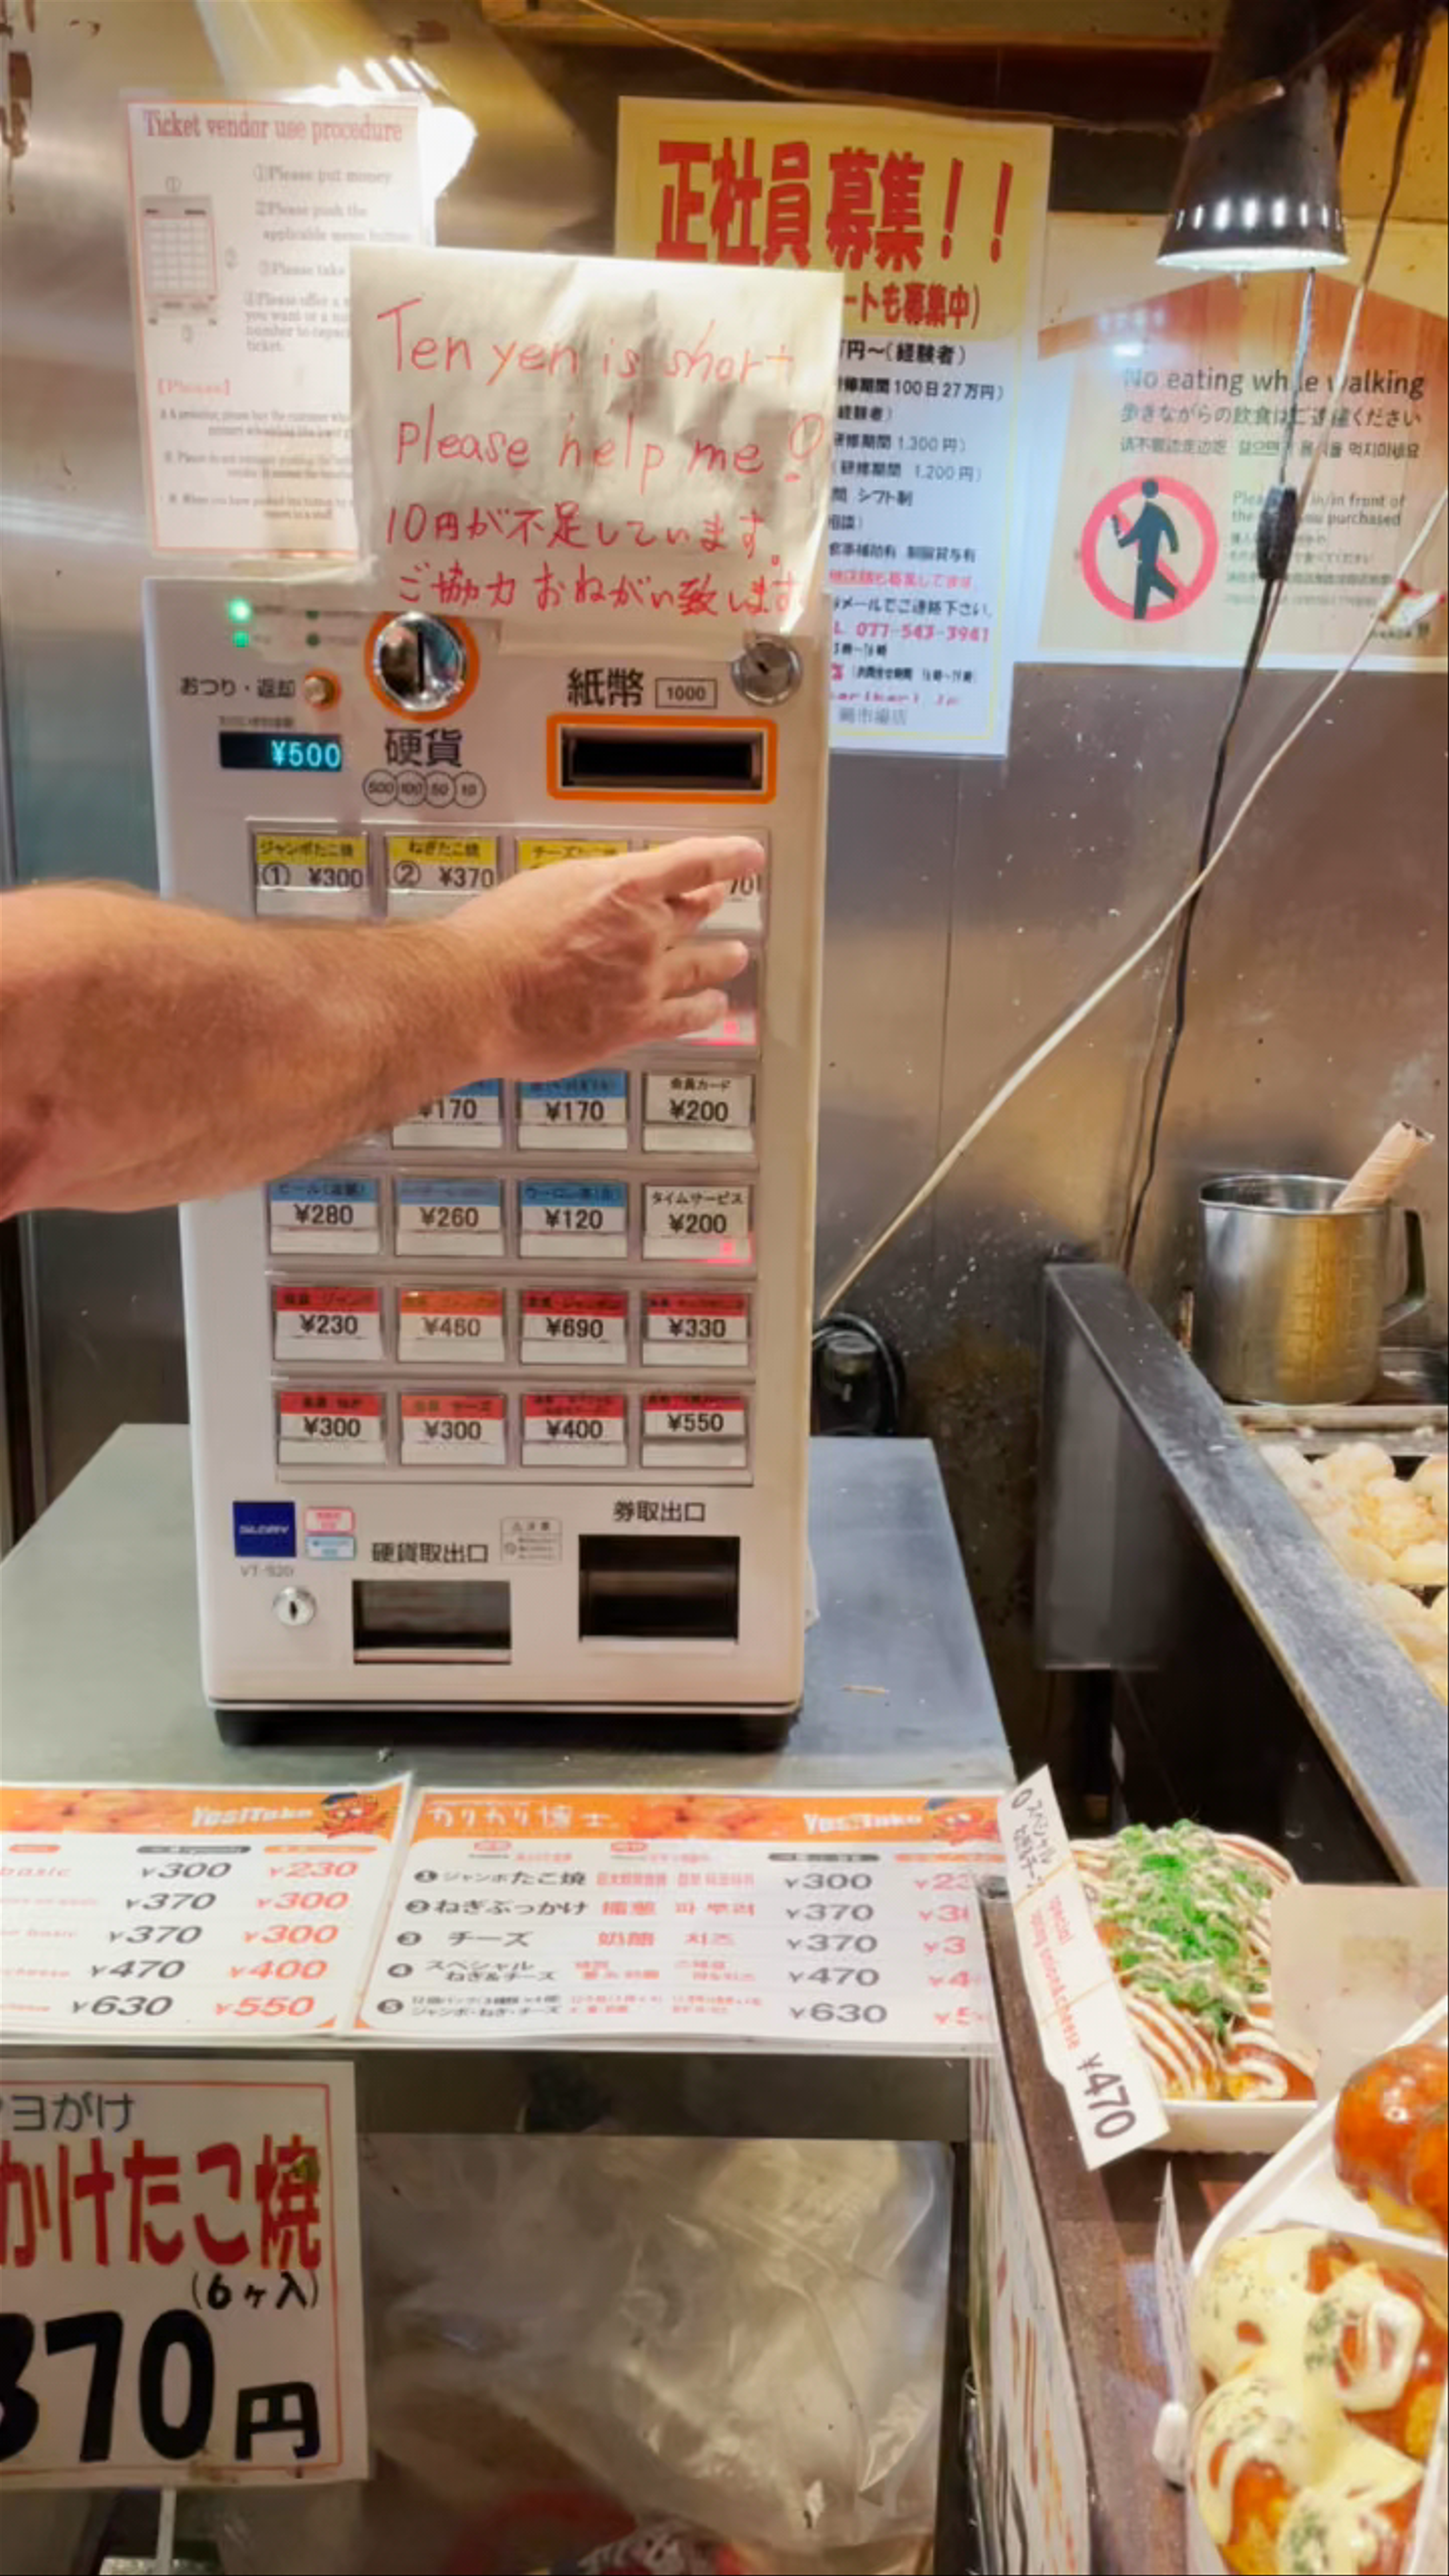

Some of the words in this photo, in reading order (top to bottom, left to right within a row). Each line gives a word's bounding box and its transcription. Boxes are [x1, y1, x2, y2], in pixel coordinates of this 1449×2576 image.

[145, 109, 200, 138] Ticket
[208, 112, 268, 140] vendor
[274, 119, 306, 140] use
[313, 114, 402, 144] procedure
[318, 168, 341, 184] put
[378, 297, 472, 372] Ten
[490, 343, 579, 386] yen
[604, 338, 640, 378] is
[665, 320, 795, 384] short
[1123, 368, 1158, 389] No
[1167, 367, 1244, 397] eating
[1253, 369, 1318, 393] whle
[559, 411, 665, 495] help
[567, 667, 644, 707] 紙幣
[666, 686, 706, 701] 1000
[272, 739, 340, 768] ¥500
[385, 728, 462, 767] 硬貨
[368, 781, 395, 795] 500
[400, 781, 423, 795] 100
[431, 782, 448, 795] 50
[461, 782, 477, 796] 10
[308, 868, 364, 888] ¥300
[438, 866, 495, 888] ¥370
[545, 1100, 605, 1122] ¥170
[669, 1100, 729, 1122] ¥200
[652, 1191, 744, 1206] タイムサービス
[293, 1204, 354, 1225] ¥280
[419, 1207, 480, 1227] ¥260
[545, 1209, 604, 1229] ¥120
[668, 1213, 727, 1234] ¥200
[298, 1314, 358, 1335] ¥230
[545, 1317, 604, 1339] ¥690
[668, 1318, 726, 1338] ¥330
[303, 1416, 362, 1438] ¥300
[424, 1420, 482, 1440] ¥300
[546, 1419, 604, 1439] ¥400
[666, 1412, 724, 1433] ¥550
[613, 1500, 706, 1523] 券取出口
[371, 1541, 489, 1564] 硬貨取出口
[142, 1862, 232, 1879] ¥300
[269, 1861, 359, 1879] ¥230
[785, 1873, 873, 1891] ¥300
[126, 1893, 217, 1910] ¥370
[256, 1892, 350, 1910] ¥300
[434, 1899, 589, 1915] ねぎぶっかけ
[786, 1904, 875, 1922] ¥370
[109, 1925, 203, 1944] ¥370
[244, 1924, 339, 1944] ¥300
[448, 1932, 534, 1947] チーズ
[787, 1934, 878, 1953] ¥370
[91, 1960, 185, 1979] ¥470
[229, 1960, 328, 1980] ¥400
[788, 1967, 880, 1987] ¥470
[72, 1996, 173, 2016] ¥630
[214, 1996, 316, 2017] ¥550
[790, 2002, 888, 2024] ¥630
[1076, 2052, 1137, 2139] ¥470
[0, 2093, 135, 2133] ヨがけ
